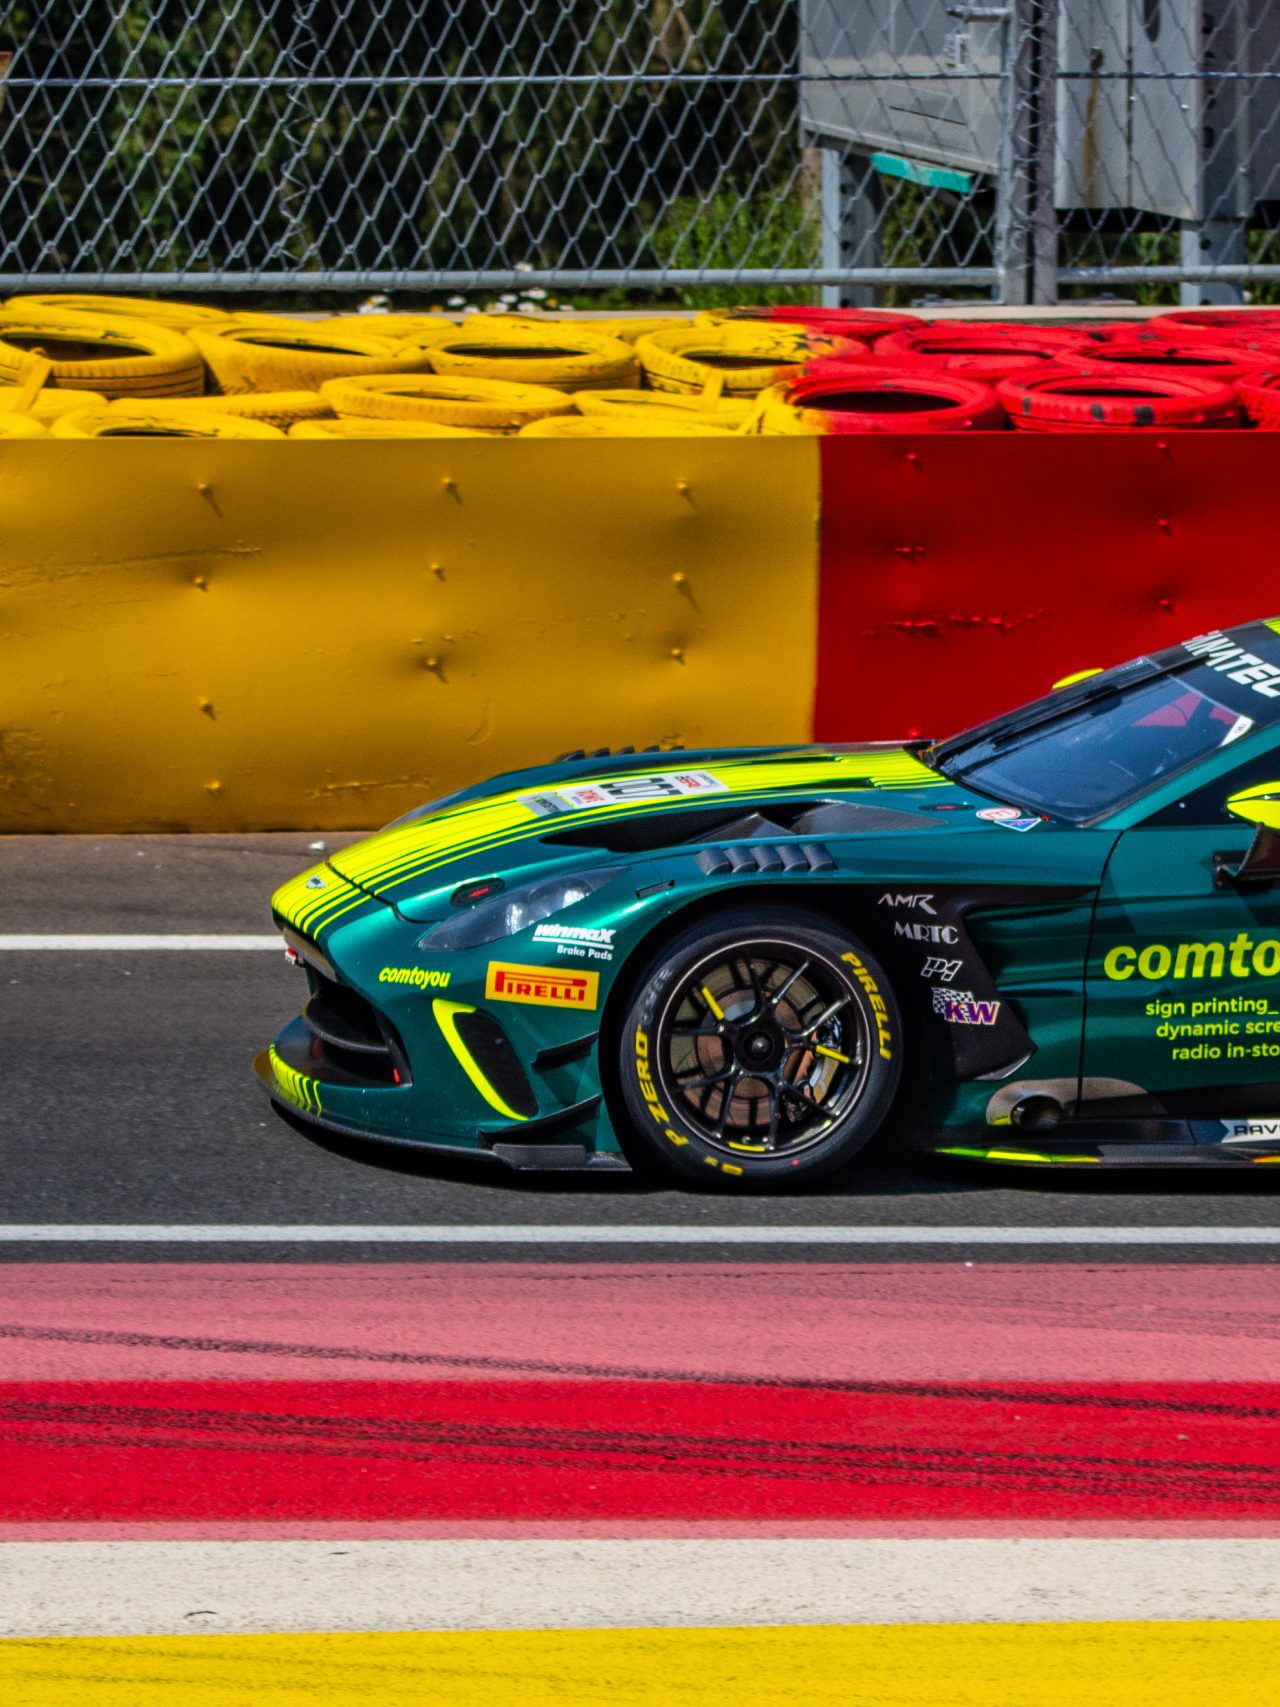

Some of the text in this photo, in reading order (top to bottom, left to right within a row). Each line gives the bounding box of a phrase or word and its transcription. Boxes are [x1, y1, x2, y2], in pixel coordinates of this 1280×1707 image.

[877, 893, 938, 915] AMR
[893, 921, 959, 945] MRTC
[557, 944, 613, 961] Brake Pads
[379, 966, 451, 990] comtoyou
[494, 970, 588, 1002] PIRELLI
[841, 951, 892, 1060] PIRELLI
[943, 1000, 1001, 1026] KW
[1145, 997, 1280, 1019] sign printing_
[1155, 1020, 1241, 1041] dynamic
[1172, 1043, 1221, 1060] radio
[635, 1030, 671, 1124] ZERO
[665, 1128, 690, 1147] P
